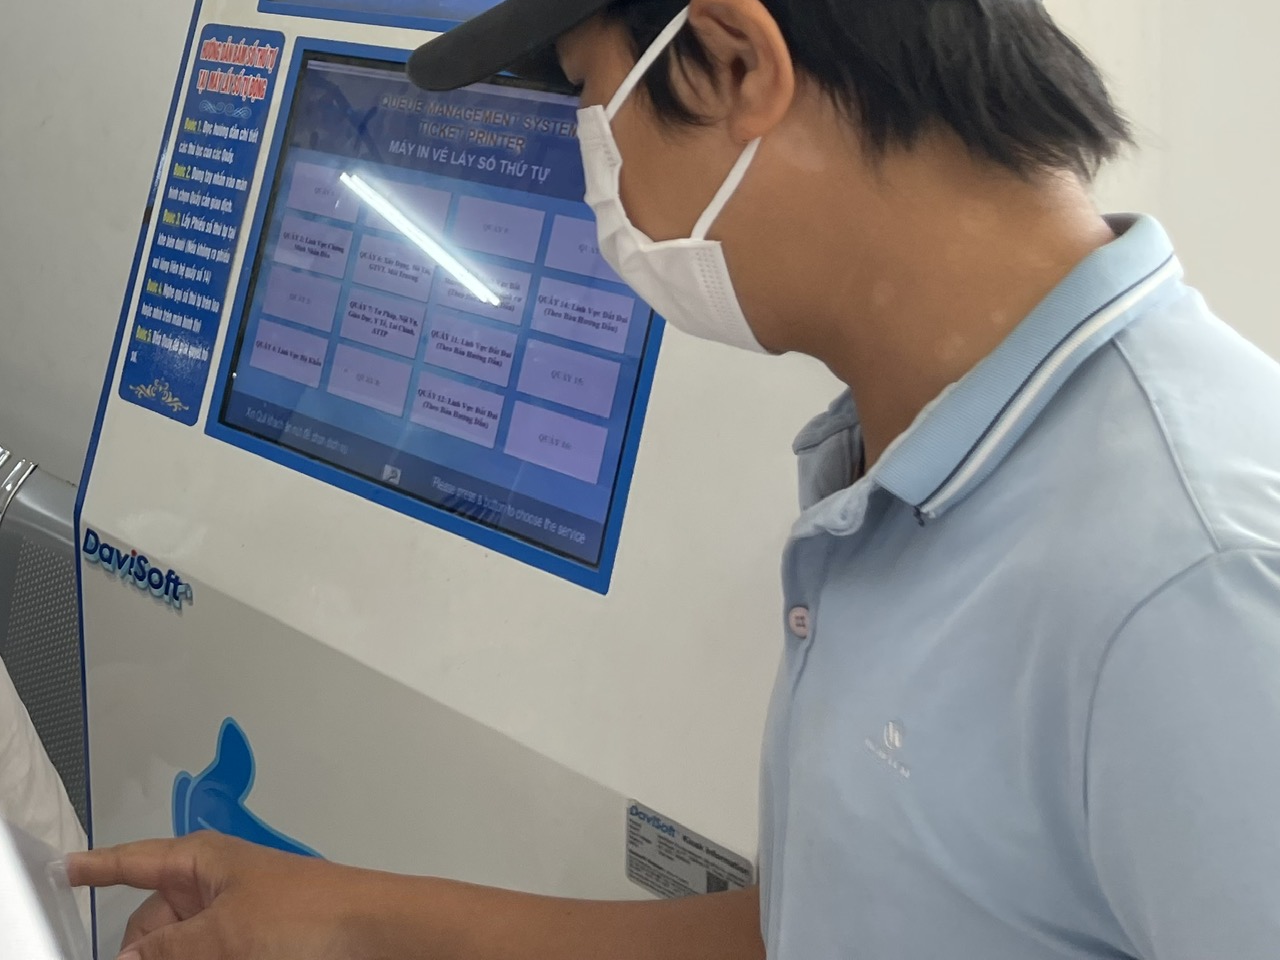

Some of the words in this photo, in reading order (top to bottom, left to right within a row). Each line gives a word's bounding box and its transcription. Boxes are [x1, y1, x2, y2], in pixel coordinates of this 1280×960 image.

[380, 92, 424, 113] QUEUE
[426, 99, 520, 128] MANAGEMENT
[416, 119, 465, 142] TICKET
[466, 127, 527, 153] PRINTER
[388, 135, 416, 156] MÁY
[415, 143, 429, 159] IN
[430, 144, 449, 163] VÉ
[497, 156, 529, 178] THỨ
[528, 164, 551, 185] TỰ
[82, 527, 184, 606] DaviSoft
[629, 805, 676, 838] DaviSoft
